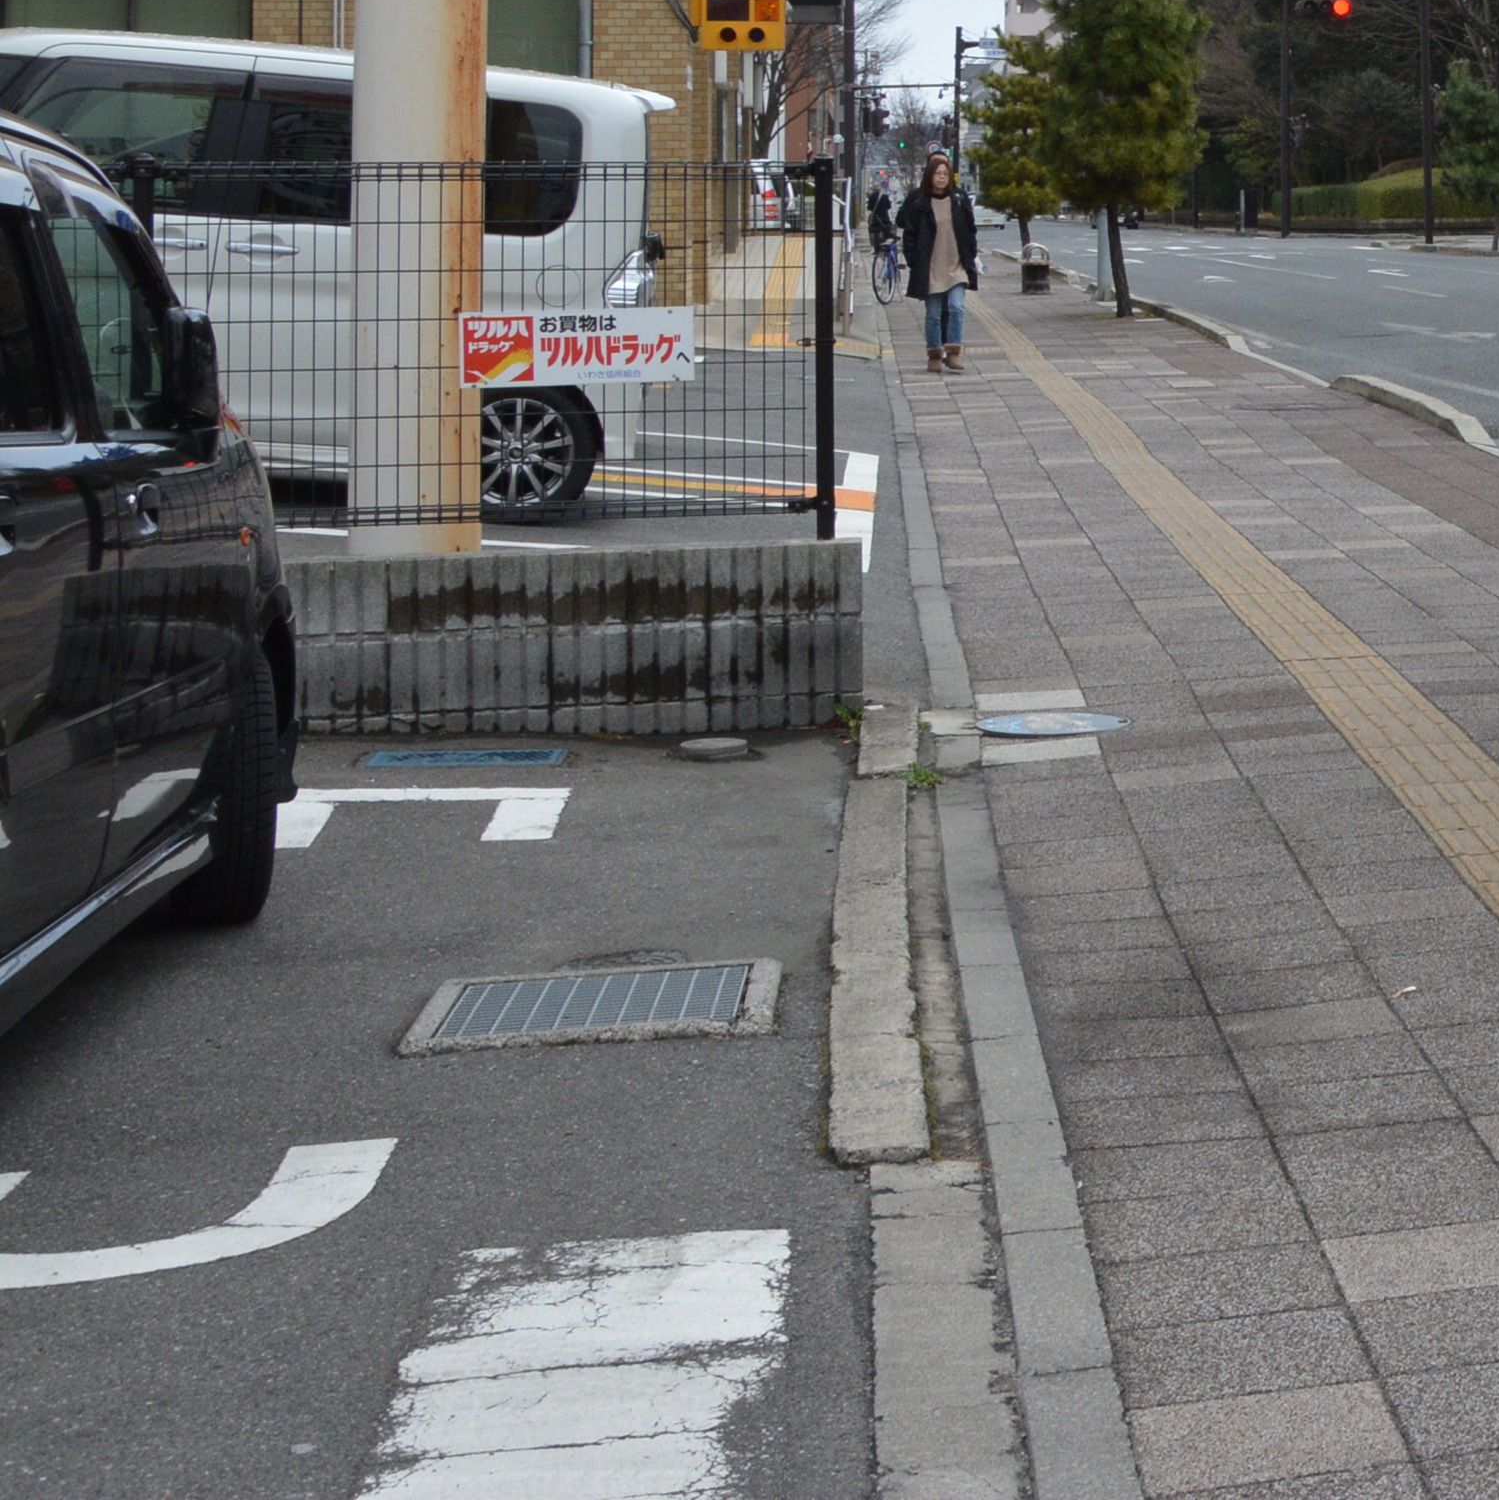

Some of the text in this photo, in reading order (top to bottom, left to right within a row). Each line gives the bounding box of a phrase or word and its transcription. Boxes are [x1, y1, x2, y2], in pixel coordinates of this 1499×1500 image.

[467, 319, 529, 339] ツルハ
[539, 315, 617, 333] お買物は
[468, 340, 515, 355] ドラッグ
